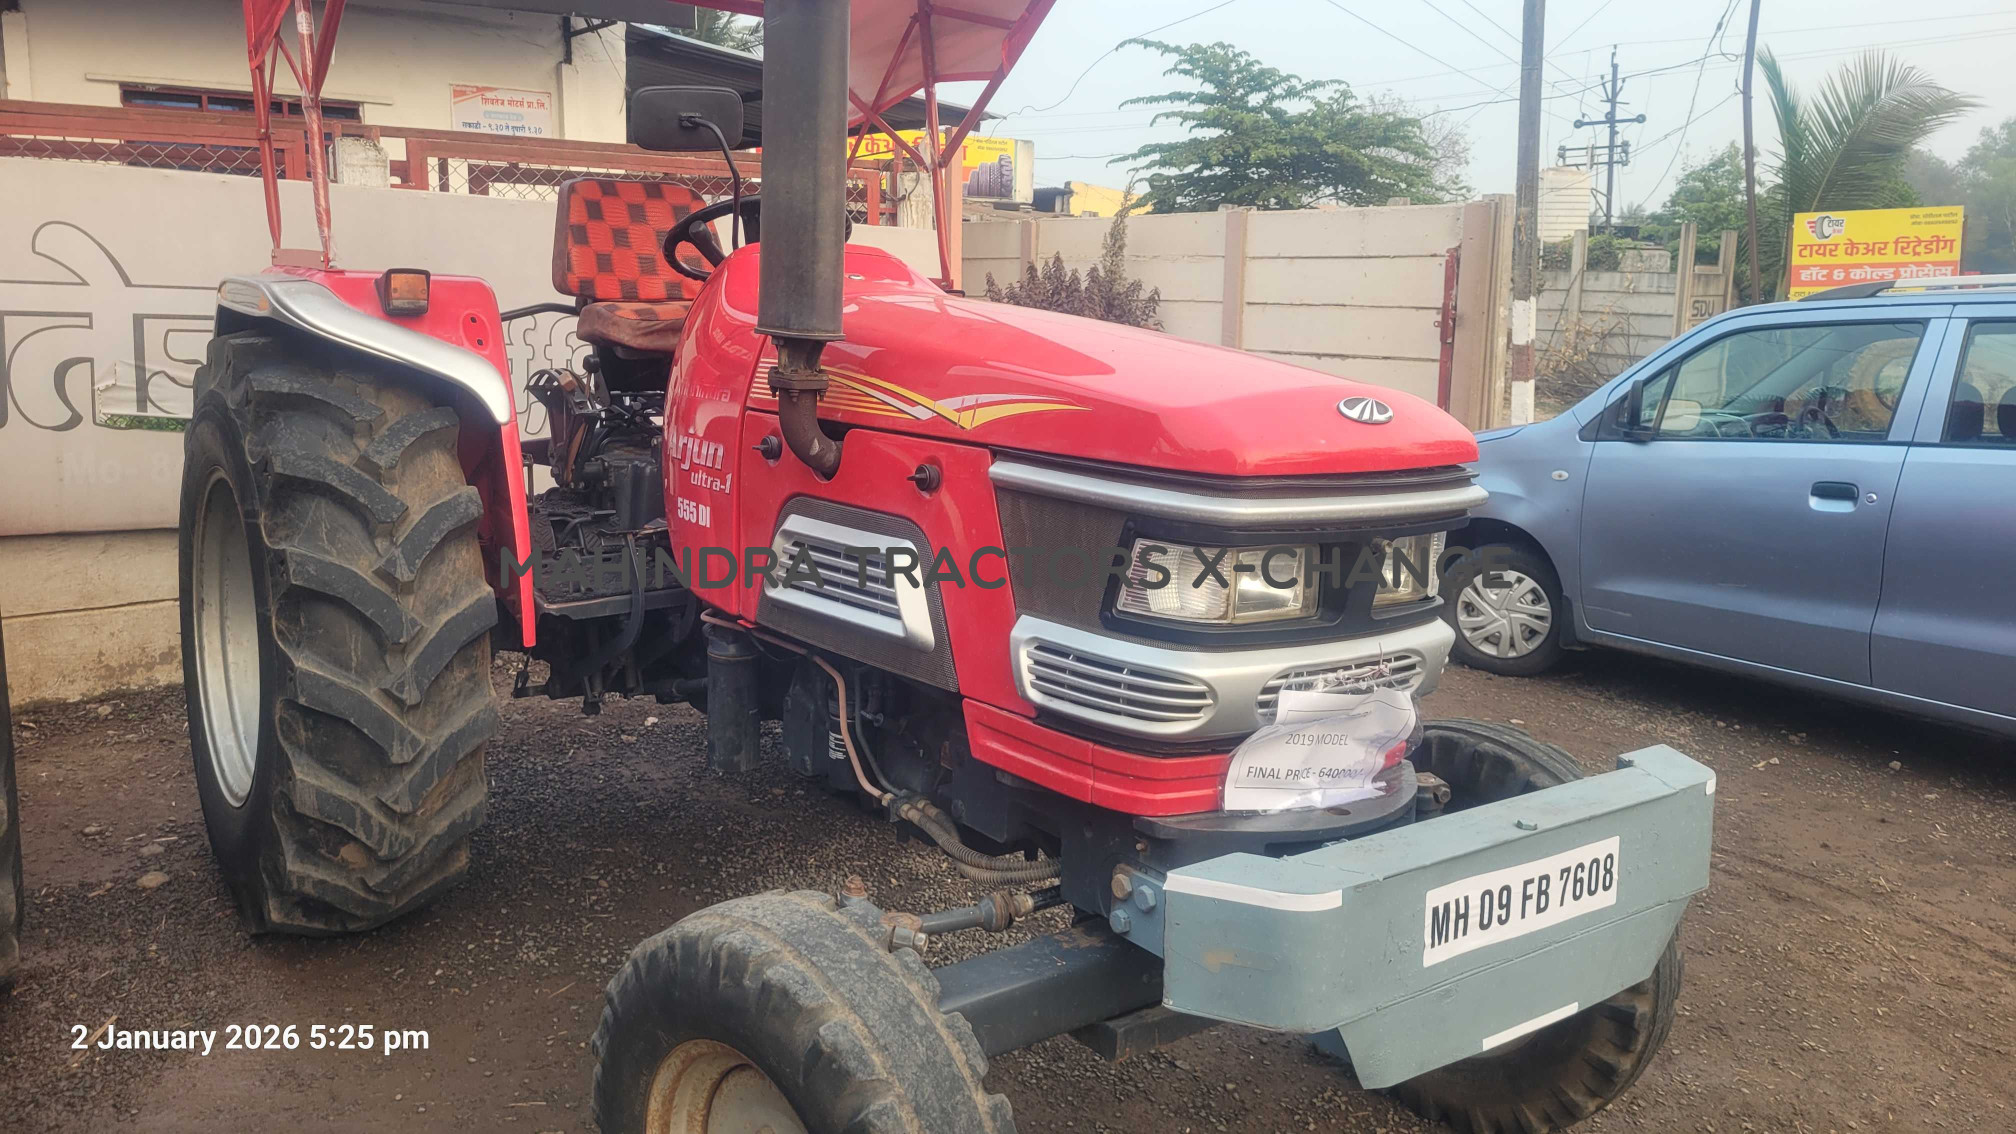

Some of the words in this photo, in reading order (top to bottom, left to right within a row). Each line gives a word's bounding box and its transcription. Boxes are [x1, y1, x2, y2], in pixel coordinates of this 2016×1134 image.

[481, 94, 505, 107] शिवतेज
[1827, 218, 1845, 228] टायर
[1797, 243, 1840, 258] टायर
[1843, 238, 1889, 257] केअर
[1800, 266, 1829, 281] हॉट
[1850, 265, 1896, 280] कोल्ड
[668, 426, 725, 470] Arjun
[690, 470, 733, 495] ultra-1
[677, 496, 697, 524] 555
[699, 503, 711, 528] DI
[1285, 733, 1314, 746] 2019
[1315, 733, 1349, 746] MODEL
[1247, 766, 1281, 780] FINAL
[1430, 895, 1470, 949] MH
[1479, 884, 1512, 931] 09
[1521, 873, 1550, 920] FB
[1559, 853, 1614, 907] 7608
